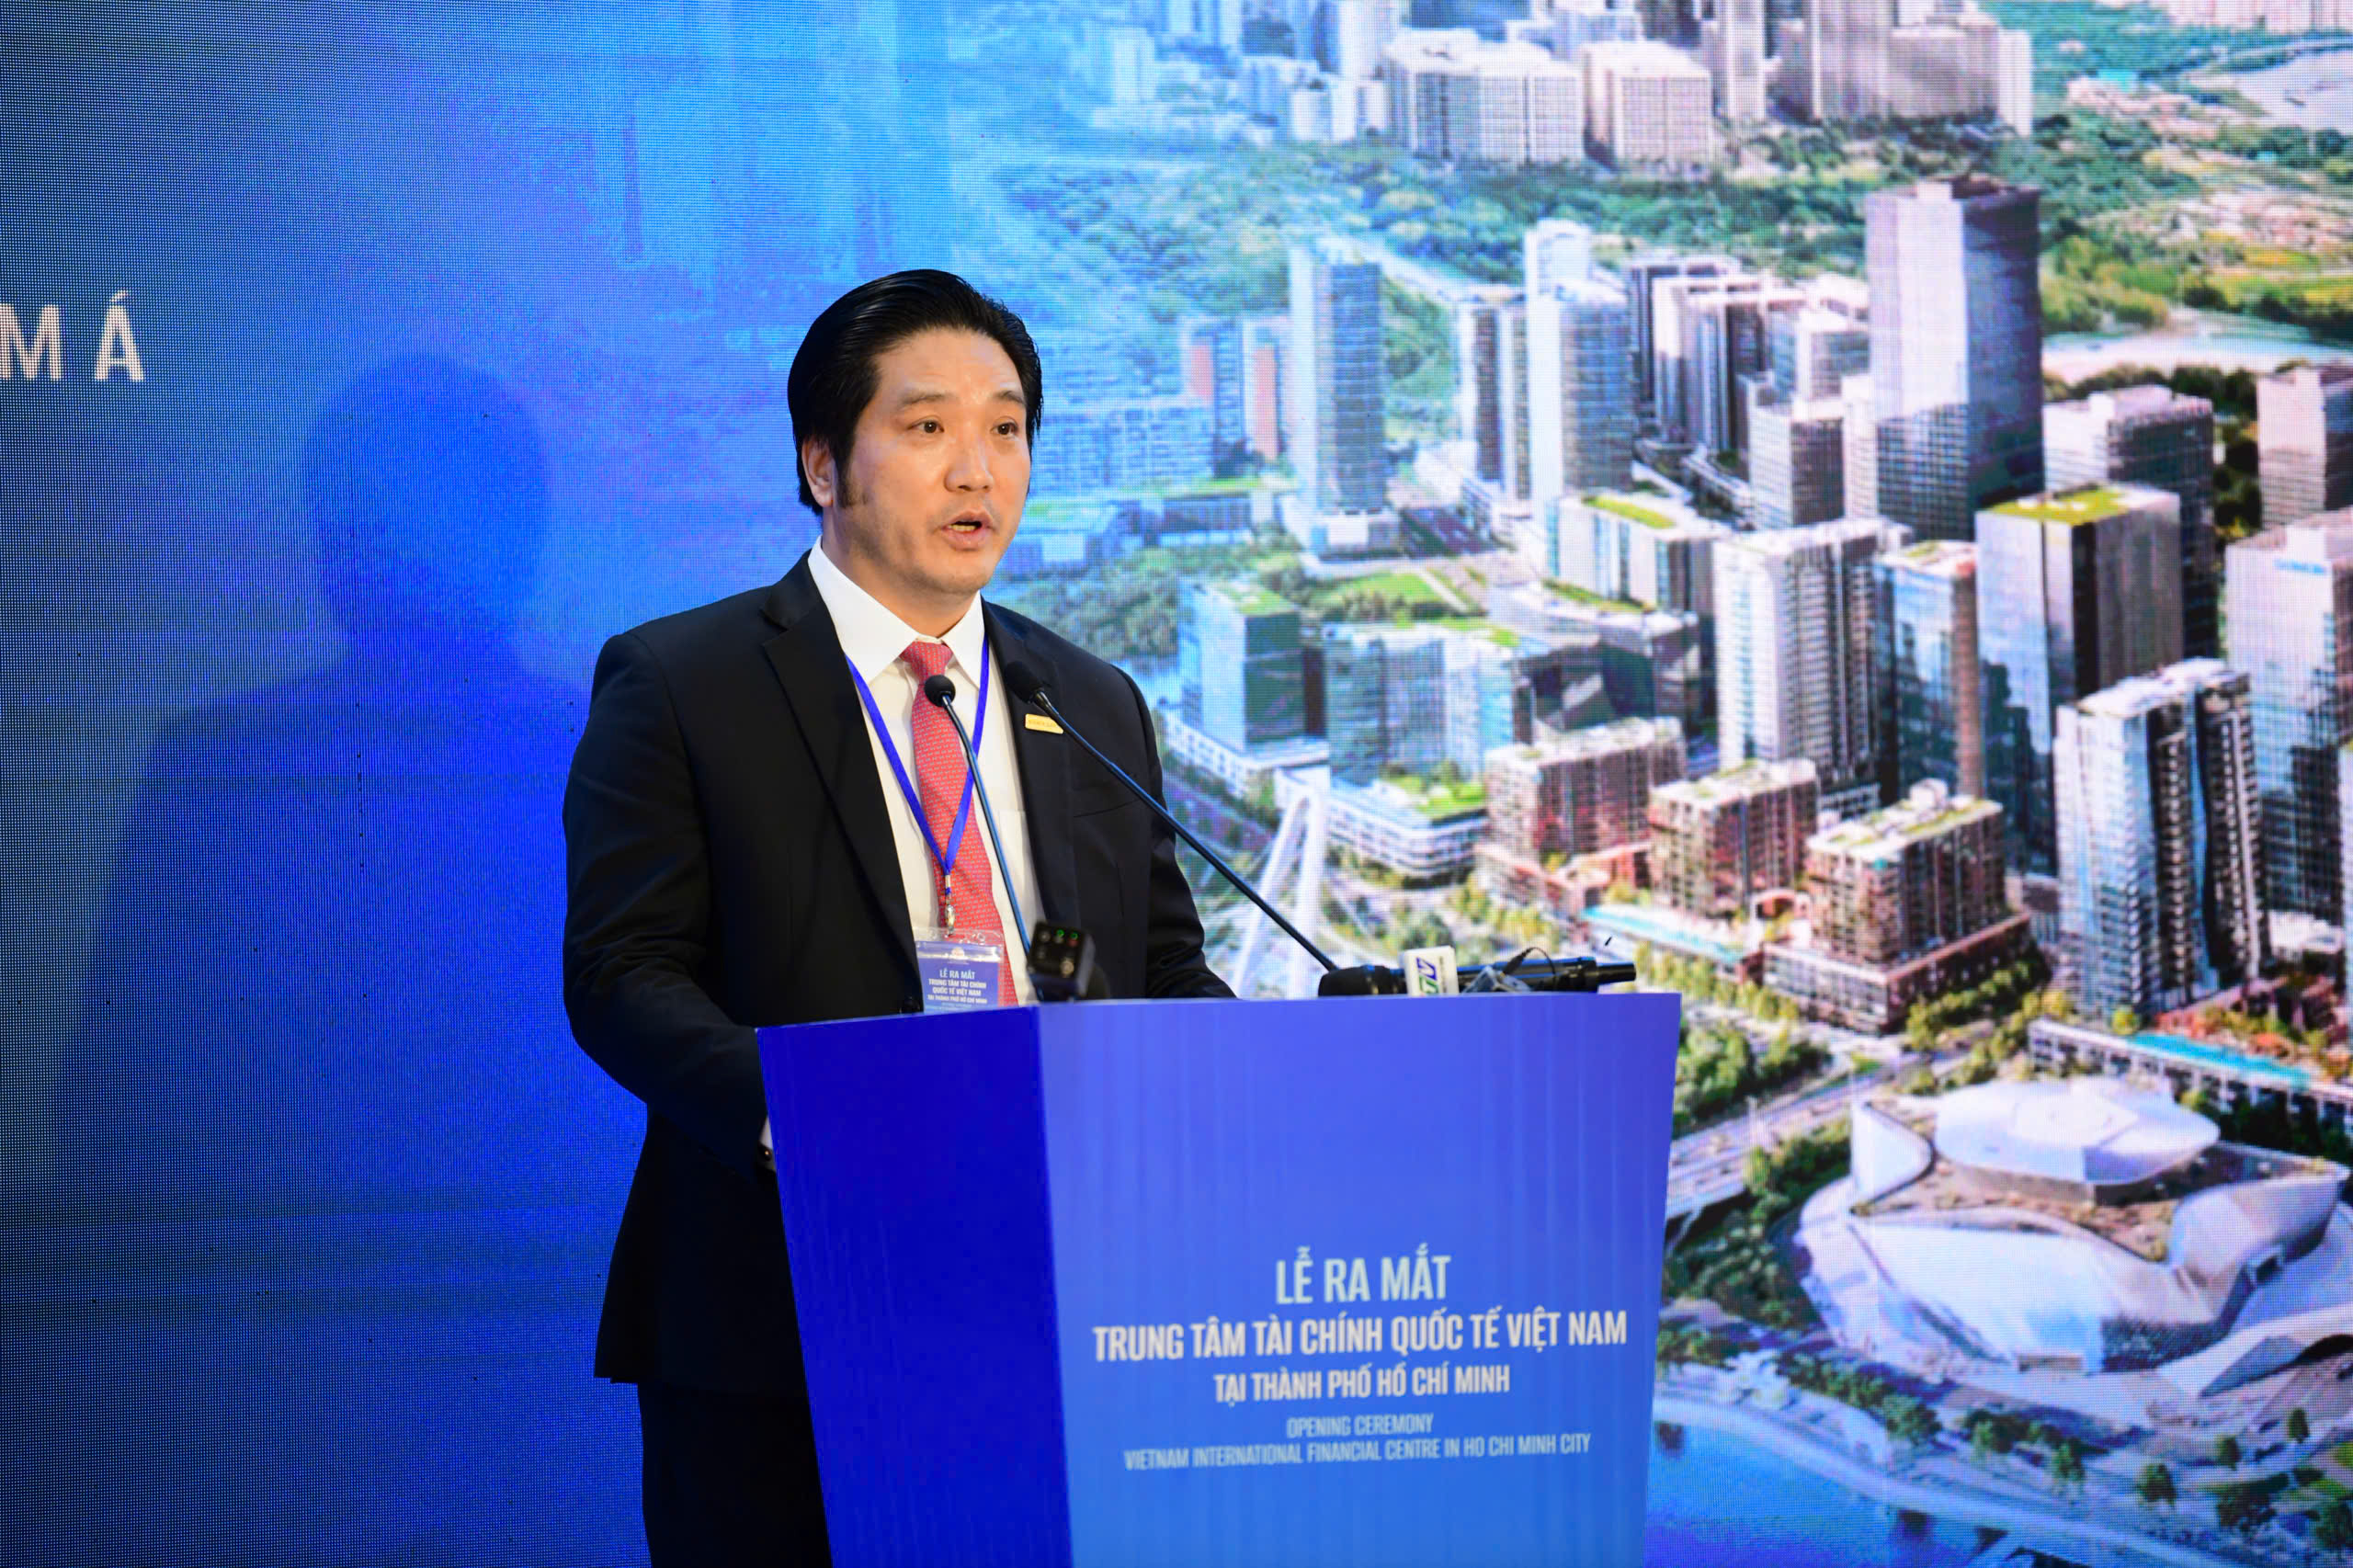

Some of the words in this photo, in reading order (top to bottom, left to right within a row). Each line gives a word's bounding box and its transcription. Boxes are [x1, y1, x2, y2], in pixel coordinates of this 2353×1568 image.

[95, 290, 144, 382] Á
[949, 970, 960, 979] RA
[1276, 1245, 1313, 1304] LỄ
[1324, 1257, 1371, 1302] RA
[1381, 1242, 1451, 1301] MẮT
[1093, 1324, 1185, 1361] TRUNG
[1190, 1315, 1245, 1358] TÂM
[1252, 1313, 1292, 1356] TÀI
[1300, 1311, 1383, 1355] CHÍNH
[1391, 1306, 1463, 1357] QUỐC
[1469, 1305, 1503, 1348] TẾ
[1506, 1305, 1561, 1353] VIỆT
[1568, 1310, 1627, 1346] NAM
[1213, 1373, 1246, 1408] TẠI
[1251, 1366, 1323, 1401] THÀNH
[1327, 1362, 1372, 1398] PHỐ
[1412, 1360, 1449, 1396] CHÍ
[1454, 1365, 1510, 1394] MINH
[1287, 1415, 1351, 1438] OPENING
[1354, 1413, 1434, 1436] CEREMONY
[1124, 1448, 1189, 1471] VIETNAM
[1192, 1443, 1302, 1467] INTERNATIONAL
[1307, 1440, 1381, 1462] FINANCIAL
[1385, 1437, 1441, 1460] CENTRE
[1444, 1437, 1461, 1458] IN
[1463, 1436, 1485, 1457] HO
[1488, 1436, 1515, 1456] CHI
[1518, 1434, 1556, 1455] MINH
[1560, 1433, 1591, 1454] CITY
